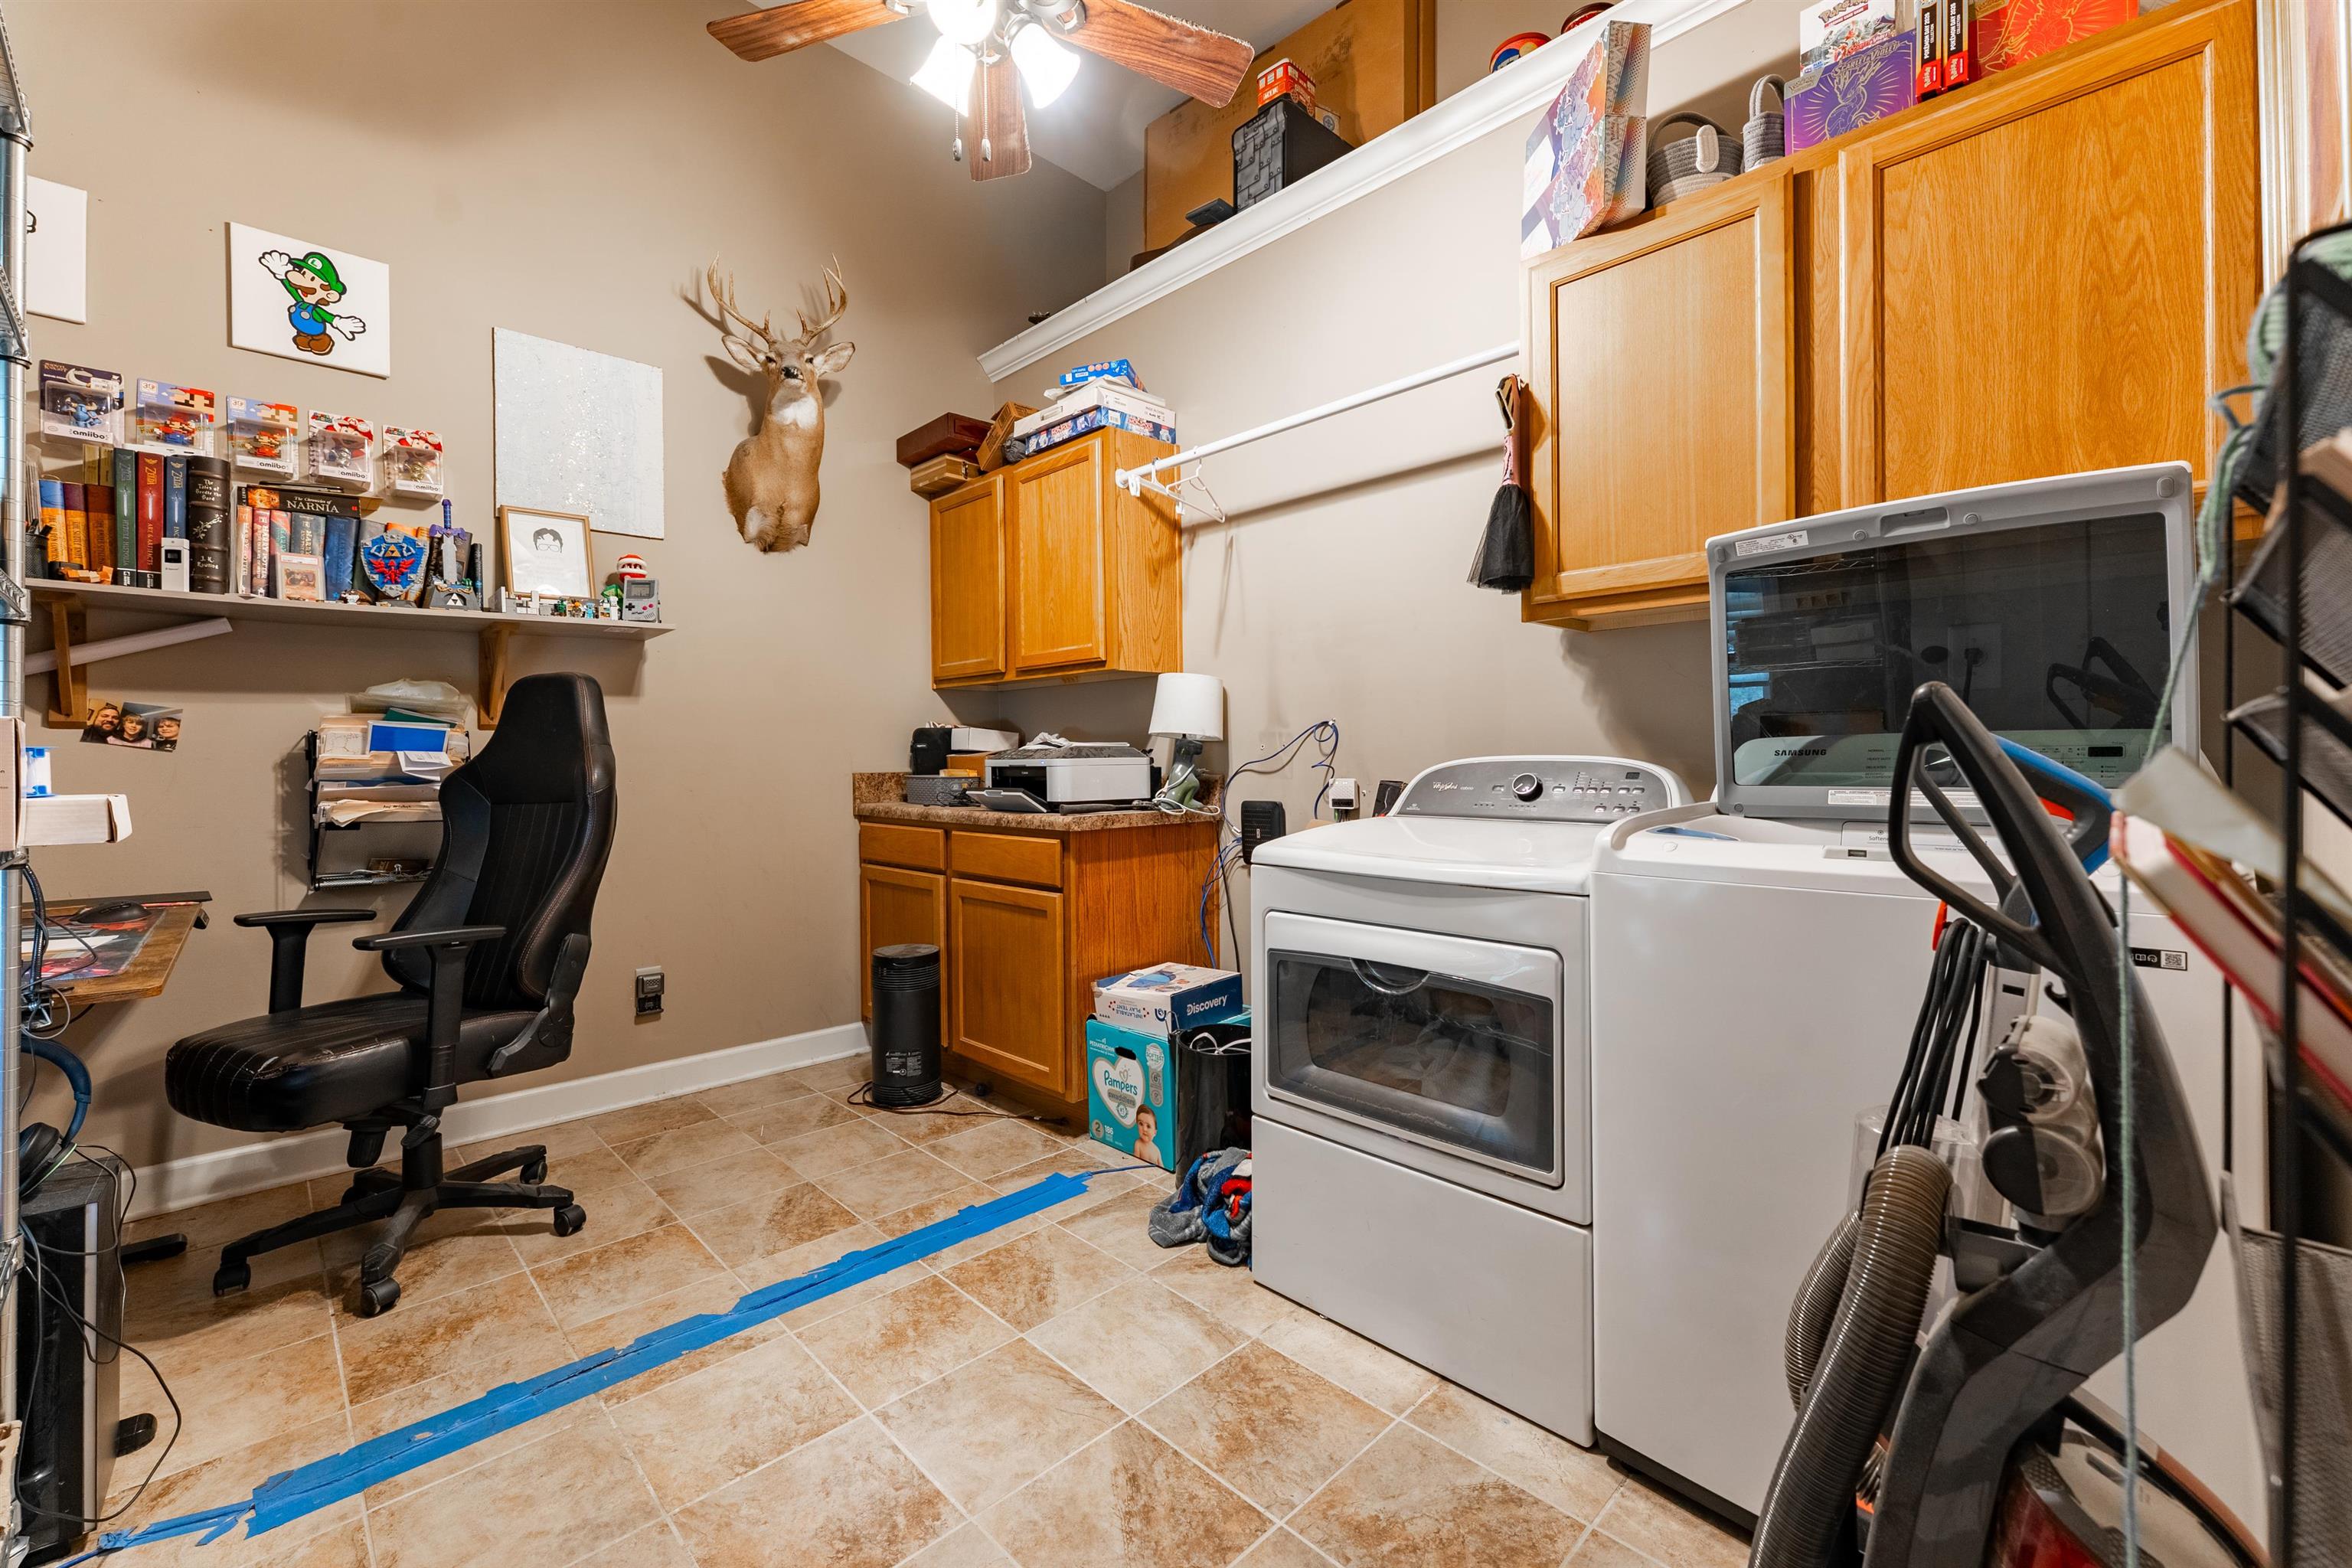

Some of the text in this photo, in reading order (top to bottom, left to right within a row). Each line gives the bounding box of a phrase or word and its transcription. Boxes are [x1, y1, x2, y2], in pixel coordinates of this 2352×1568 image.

[73, 430, 106, 440] amiibo
[259, 461, 286, 470] amiibo
[340, 471, 366, 479] amiibo
[286, 500, 340, 514] NARNIA
[1186, 995, 1229, 1017] Discovery
[1116, 1009, 1143, 1019] INFLATABLE
[1104, 1070, 1138, 1096] Pampers
[1095, 1122, 1101, 1132] 2
[1105, 1125, 1114, 1135] 186
